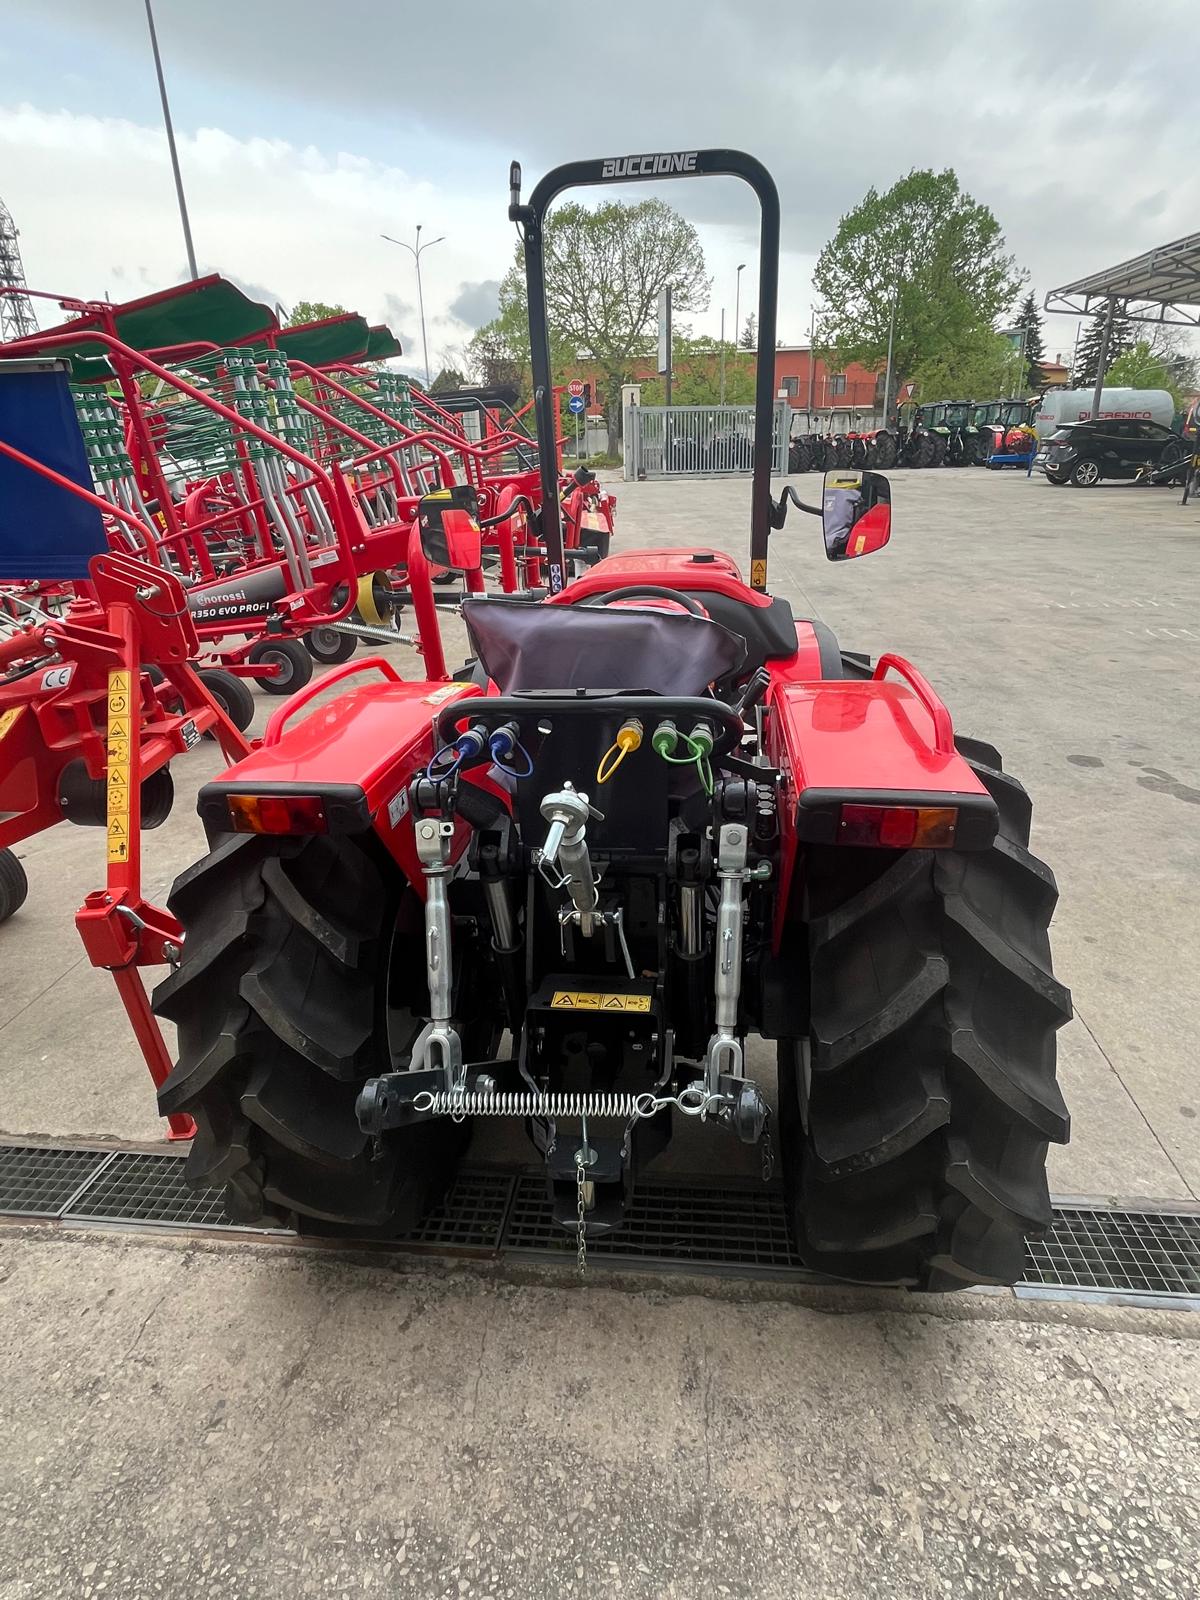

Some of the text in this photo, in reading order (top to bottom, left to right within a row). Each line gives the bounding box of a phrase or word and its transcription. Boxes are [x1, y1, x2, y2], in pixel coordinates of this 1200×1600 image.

[602, 152, 698, 178] BUCCIONE
[570, 384, 582, 392] STOP
[218, 605, 238, 616] EVO
[239, 601, 270, 613] PROFI
[45, 668, 69, 687] CE
